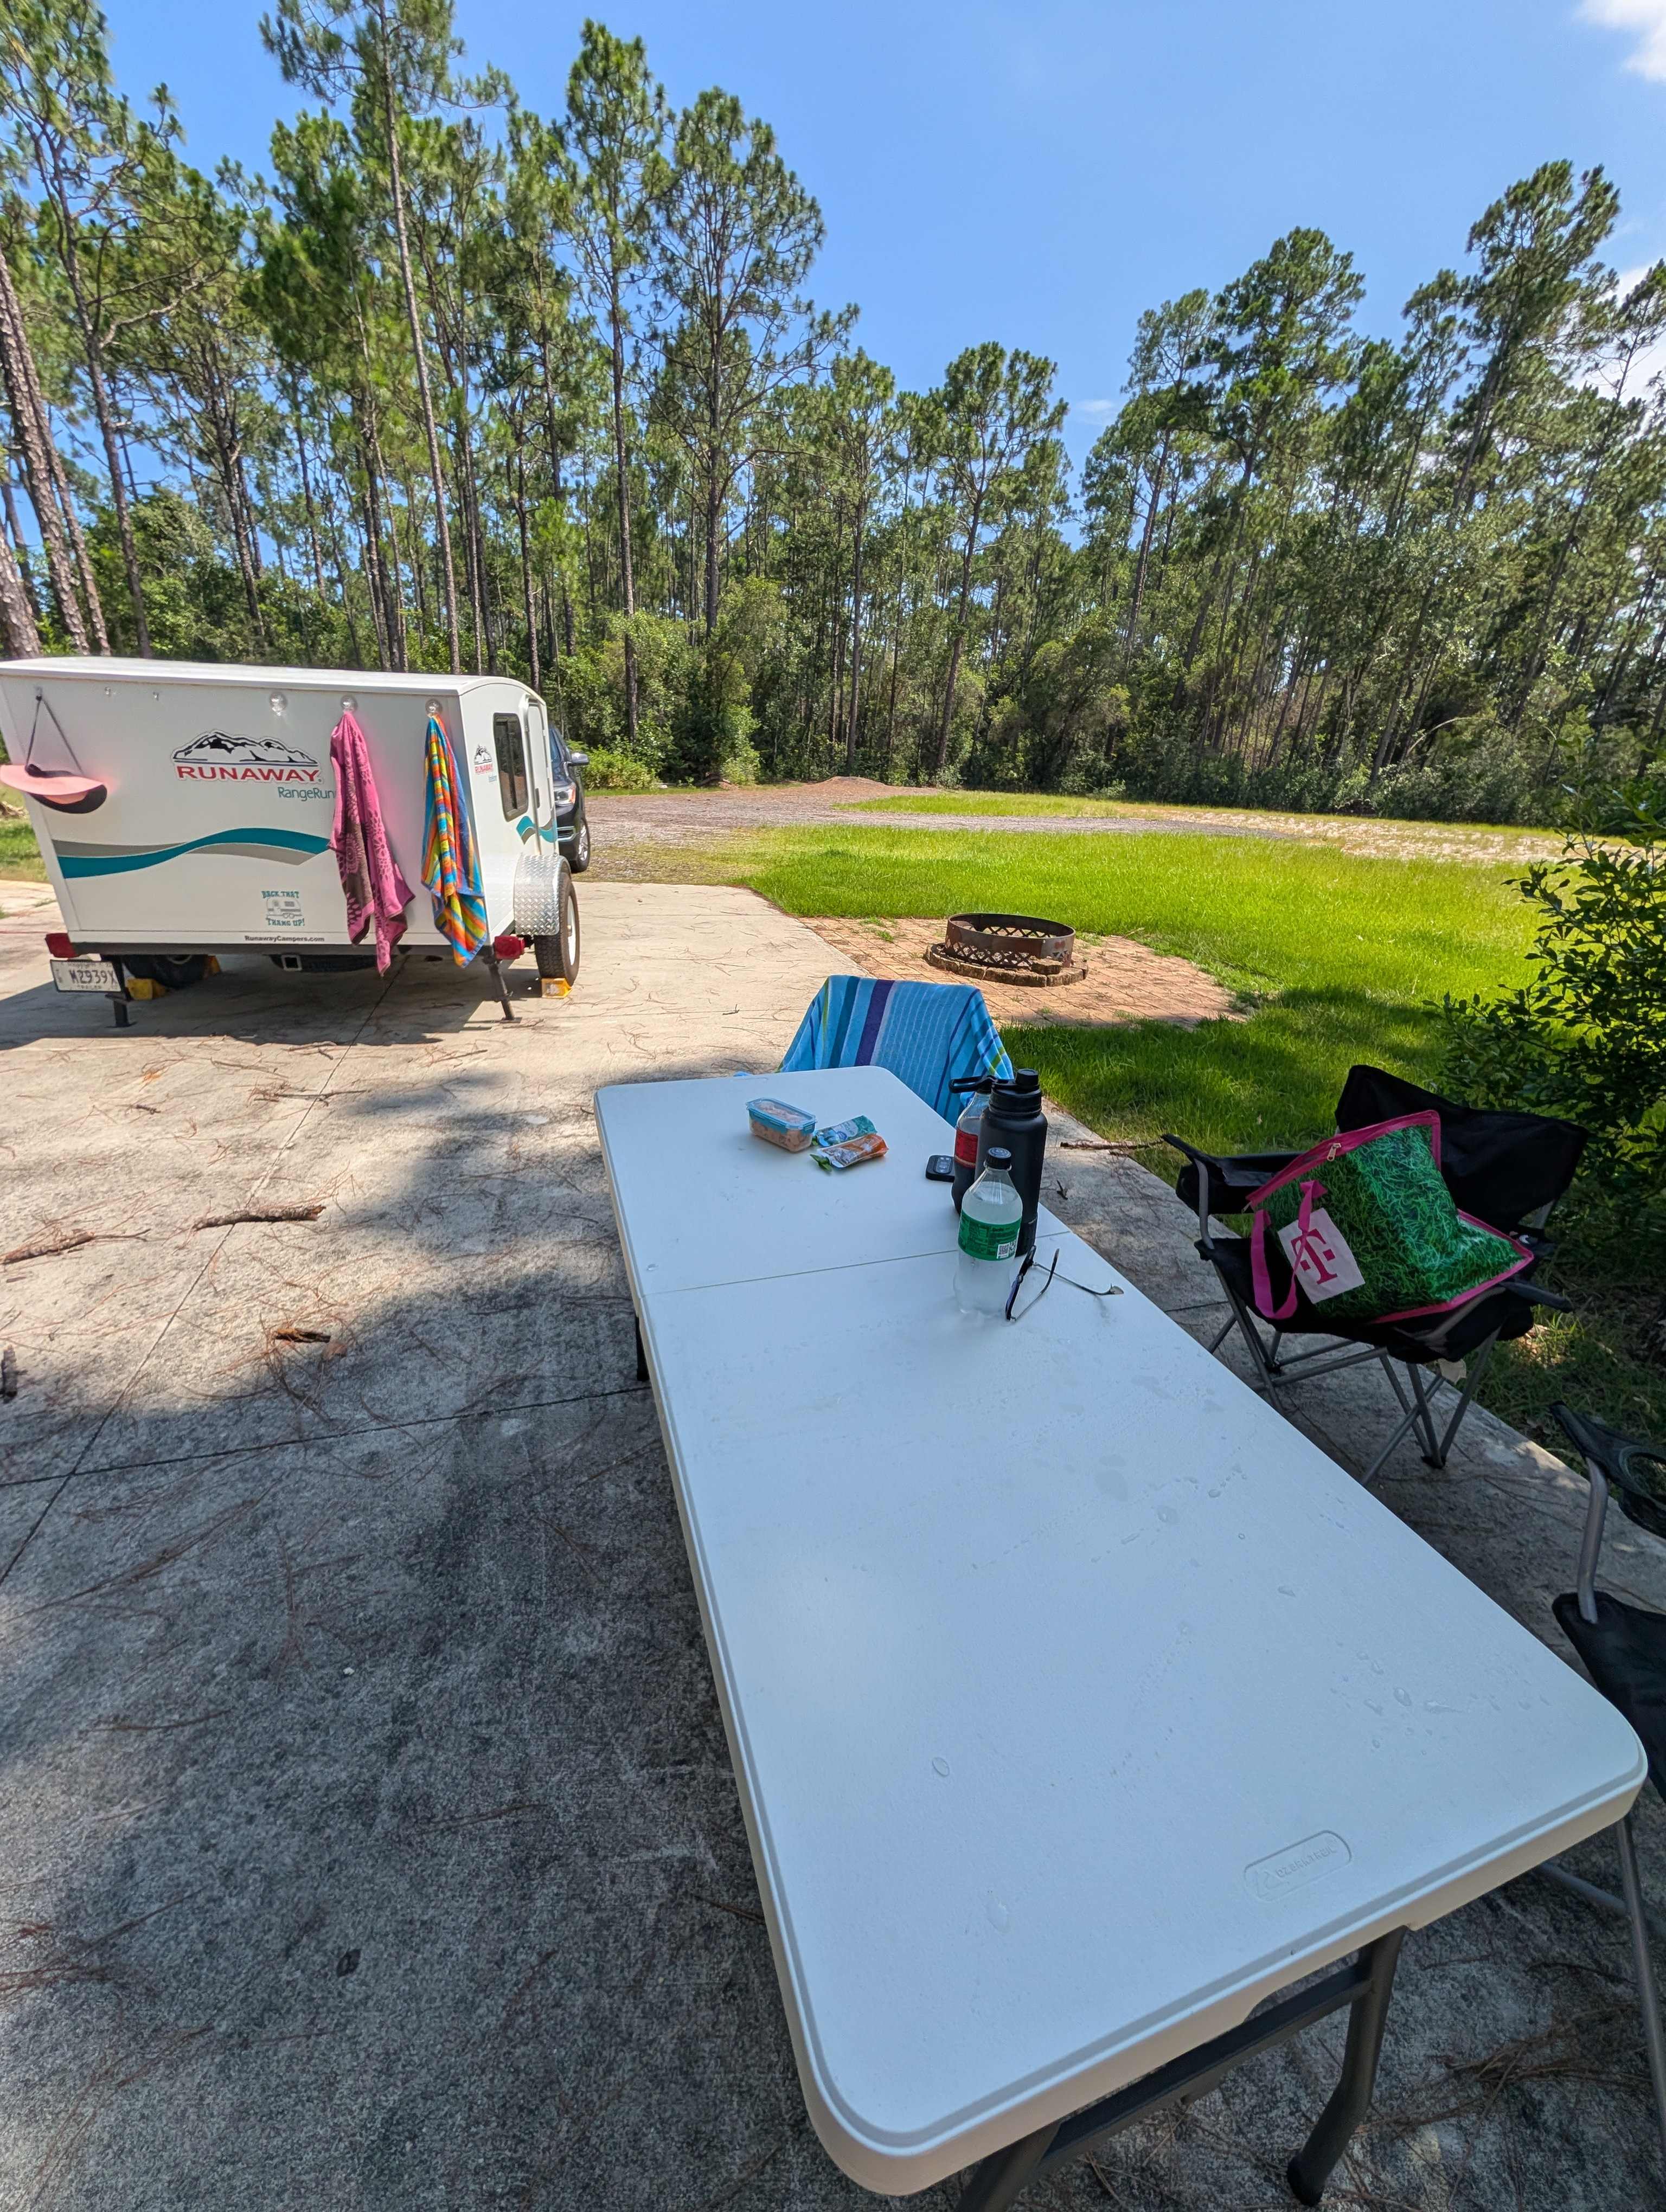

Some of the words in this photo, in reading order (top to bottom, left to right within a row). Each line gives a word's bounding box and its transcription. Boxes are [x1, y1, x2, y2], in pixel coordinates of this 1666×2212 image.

[177, 766, 319, 782] RUNAWAY
[278, 787, 336, 801] RangeRun
[1290, 1228, 1338, 1284] T
